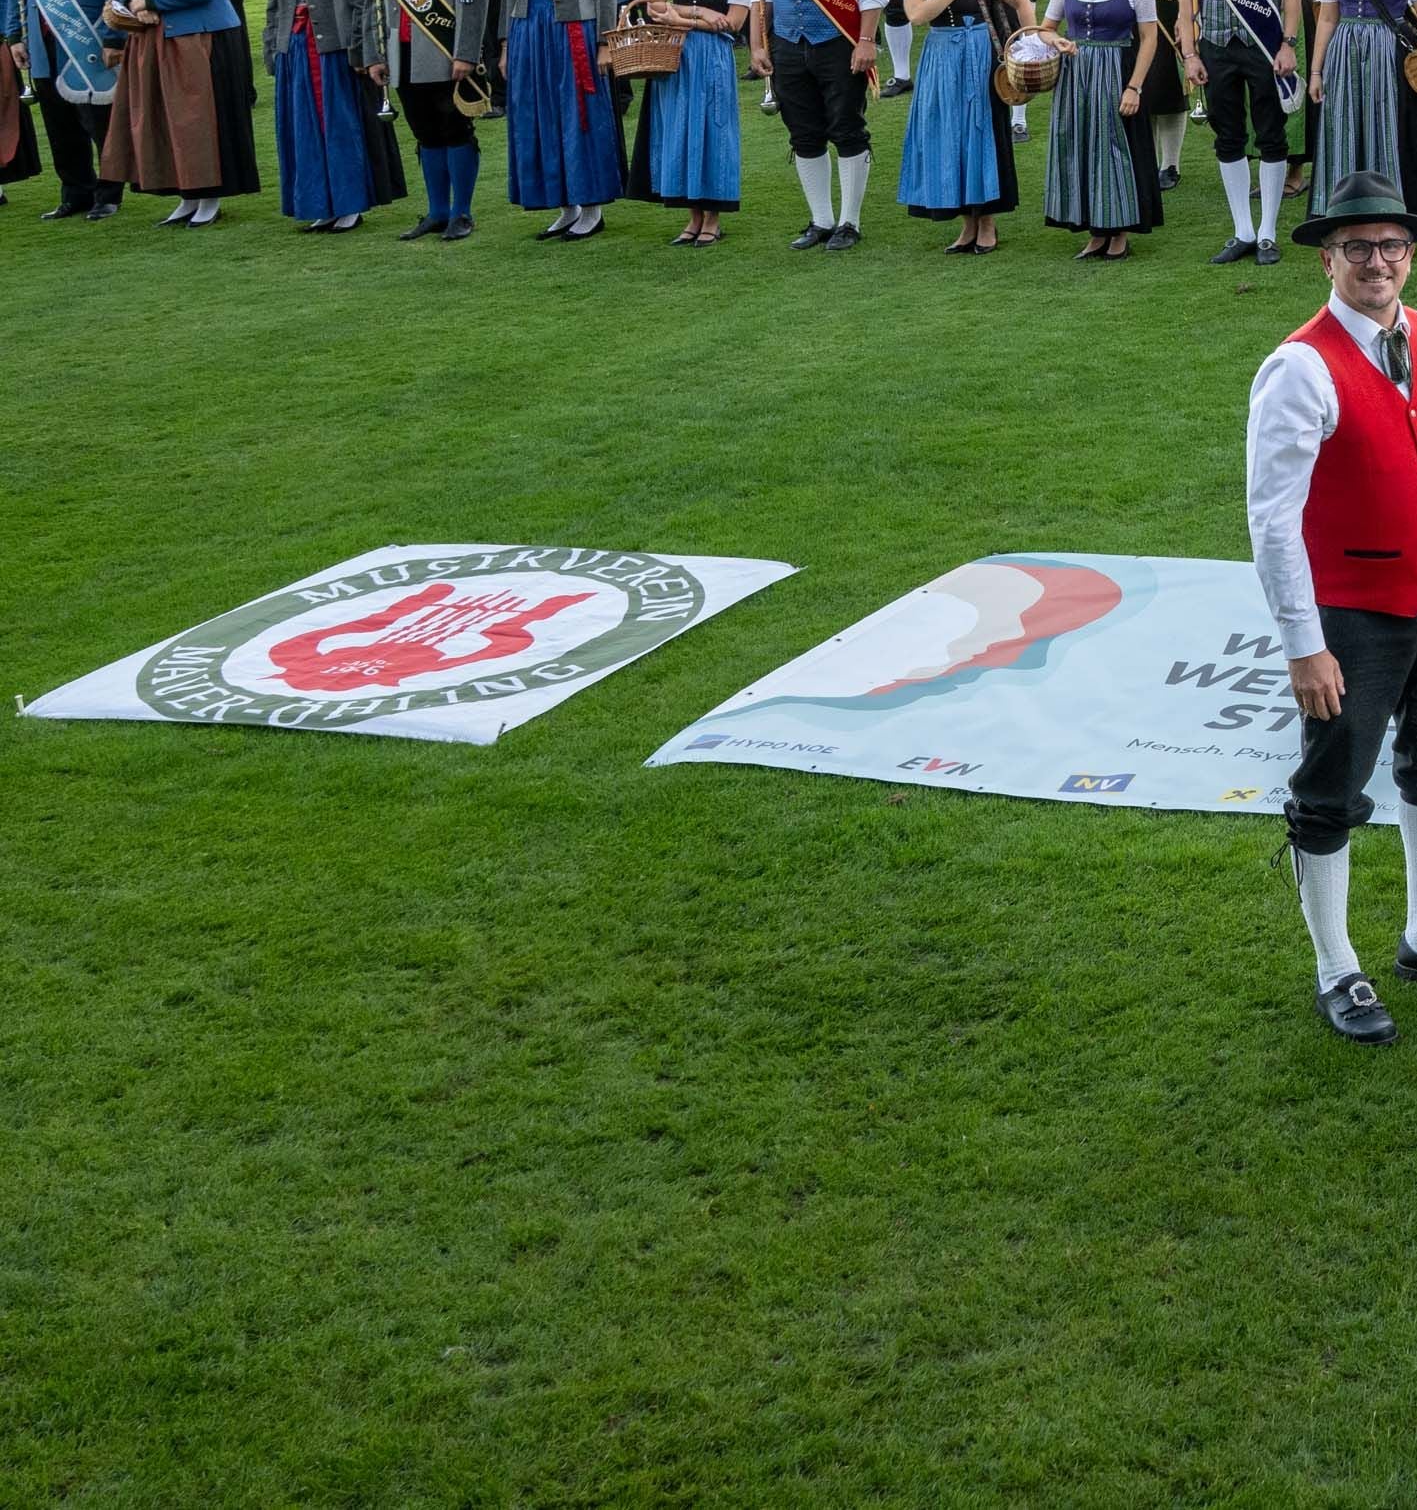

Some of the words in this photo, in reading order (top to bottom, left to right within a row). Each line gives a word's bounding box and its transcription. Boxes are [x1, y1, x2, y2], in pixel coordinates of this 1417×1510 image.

[299, 547, 693, 624] MUSIKVEREIN
[148, 645, 589, 729] MAUER-ÖHLING
[726, 738, 790, 751] HYPO
[794, 743, 841, 754] NOE
[1126, 738, 1224, 756] Mensch.
[1234, 747, 1303, 762] Psych
[897, 756, 983, 776] EVN
[1076, 776, 1124, 790] NV
